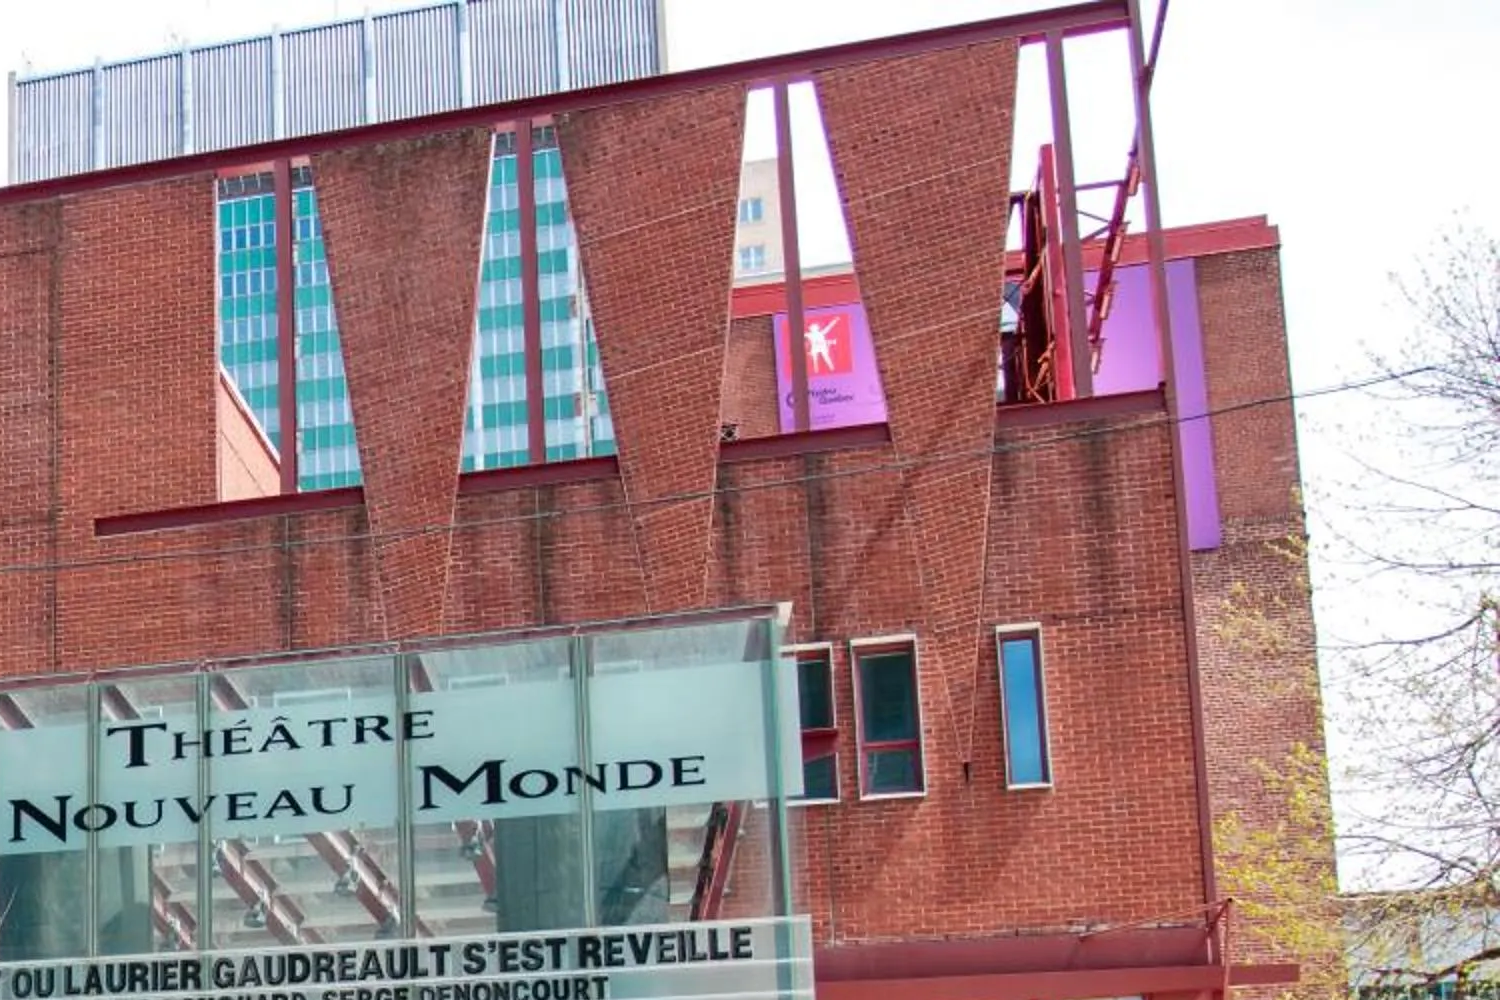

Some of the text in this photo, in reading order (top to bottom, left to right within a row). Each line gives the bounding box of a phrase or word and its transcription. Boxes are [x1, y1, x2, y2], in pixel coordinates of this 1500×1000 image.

[8, 784, 354, 843] NOUVEAU
[418, 755, 706, 810] MONDE
[12, 968, 55, 998] OU
[64, 959, 202, 996] LAURIER
[213, 944, 450, 988] GAUDREAULT
[463, 937, 566, 974] S'EST
[579, 926, 752, 968] REVEILLE
